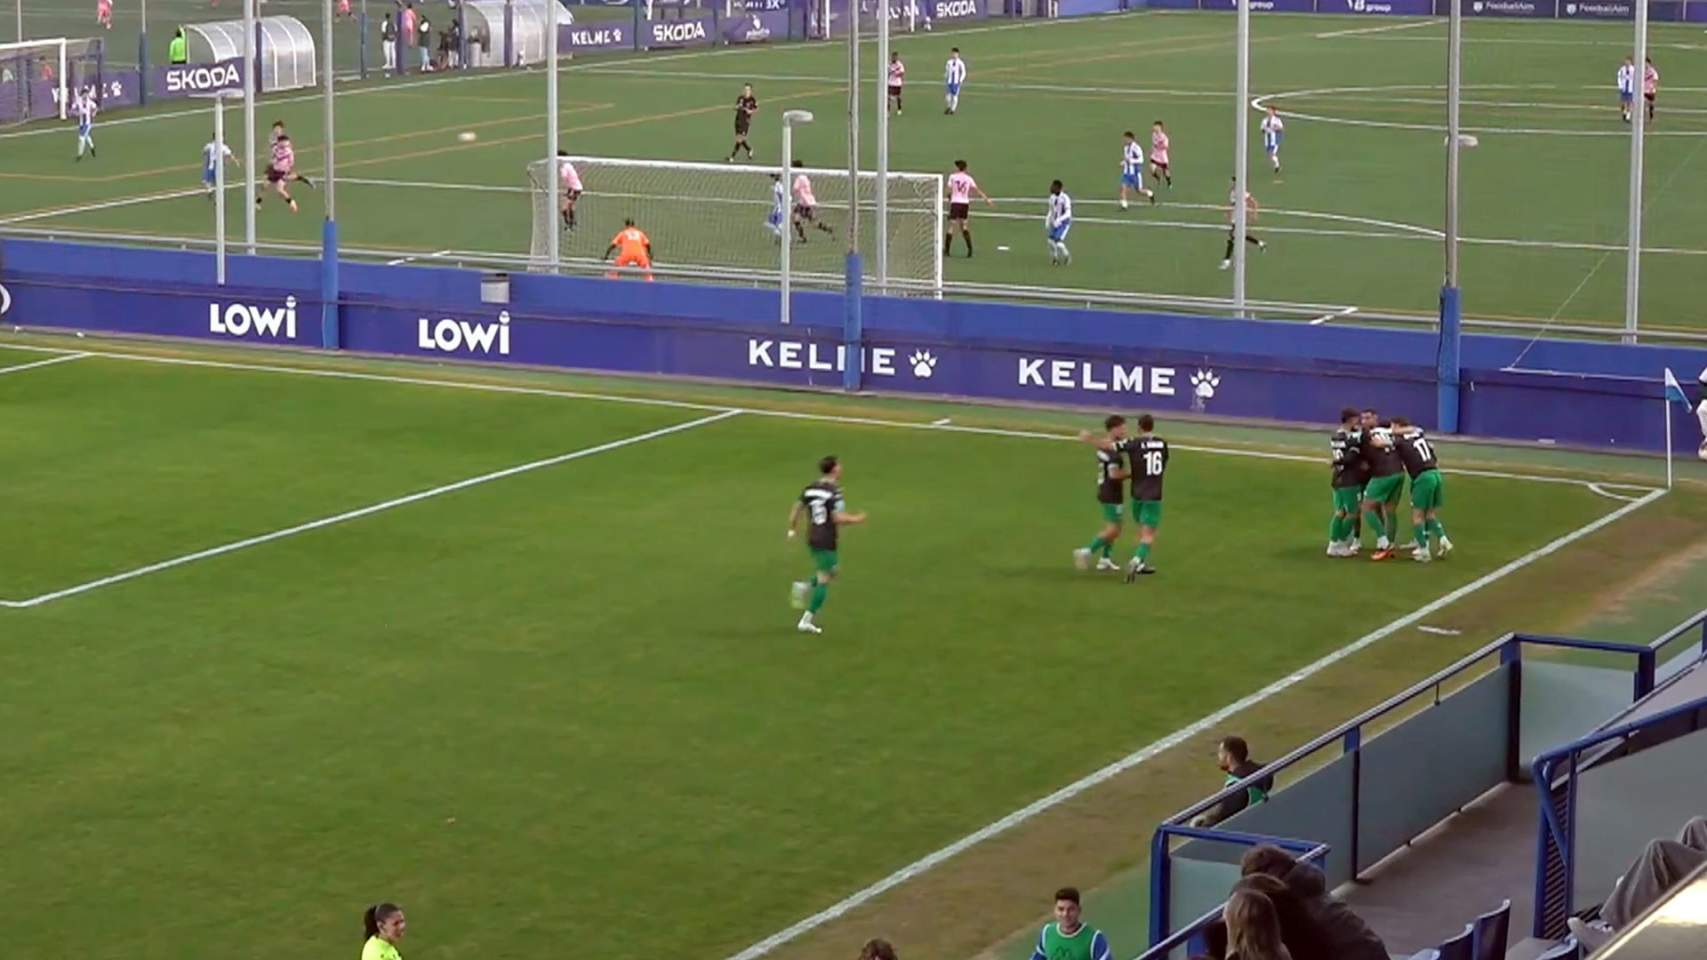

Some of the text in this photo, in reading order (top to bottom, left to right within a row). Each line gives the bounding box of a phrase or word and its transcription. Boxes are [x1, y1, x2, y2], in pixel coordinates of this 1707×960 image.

[936, 0, 977, 17] SKODA
[1366, 4, 1392, 12] group
[653, 21, 705, 42] SKODA
[167, 63, 240, 91] SKODA
[1018, 358, 1176, 396] KELME
[1413, 437, 1432, 462] 17
[1143, 450, 1163, 476] 16
